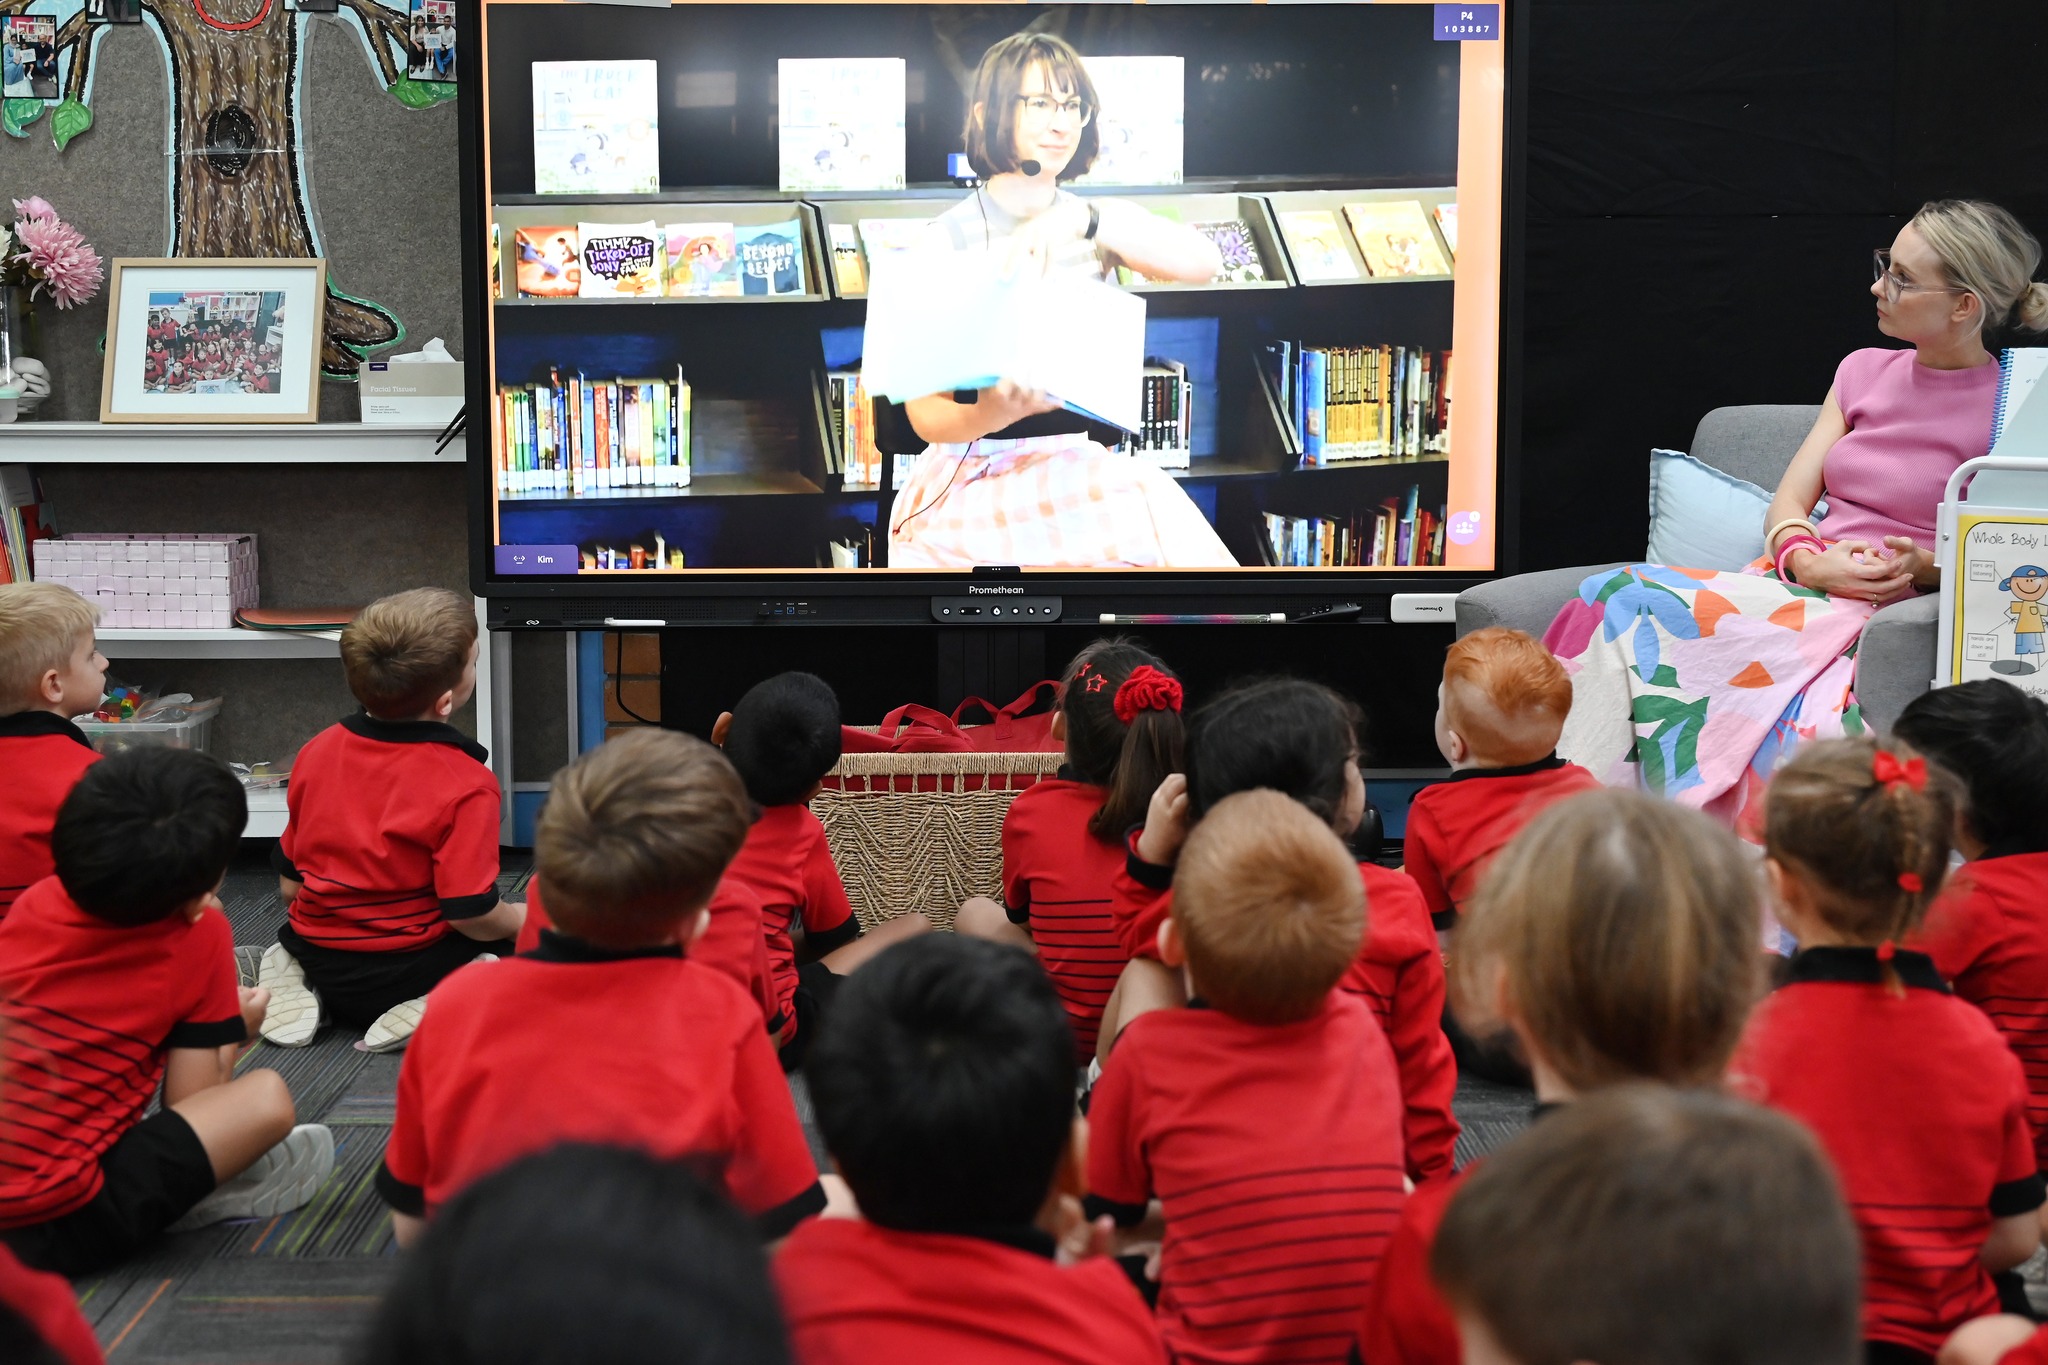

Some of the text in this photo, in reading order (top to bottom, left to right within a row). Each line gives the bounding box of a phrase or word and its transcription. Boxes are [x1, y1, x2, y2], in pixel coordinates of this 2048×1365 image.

[1461, 11, 1473, 21] P4
[590, 237, 632, 251] TIMMY
[590, 261, 619, 273] PONY
[1972, 531, 2005, 545] Whole
[2011, 533, 2039, 549] Body
[537, 555, 553, 564] Kim
[969, 586, 1024, 594] Promethean
